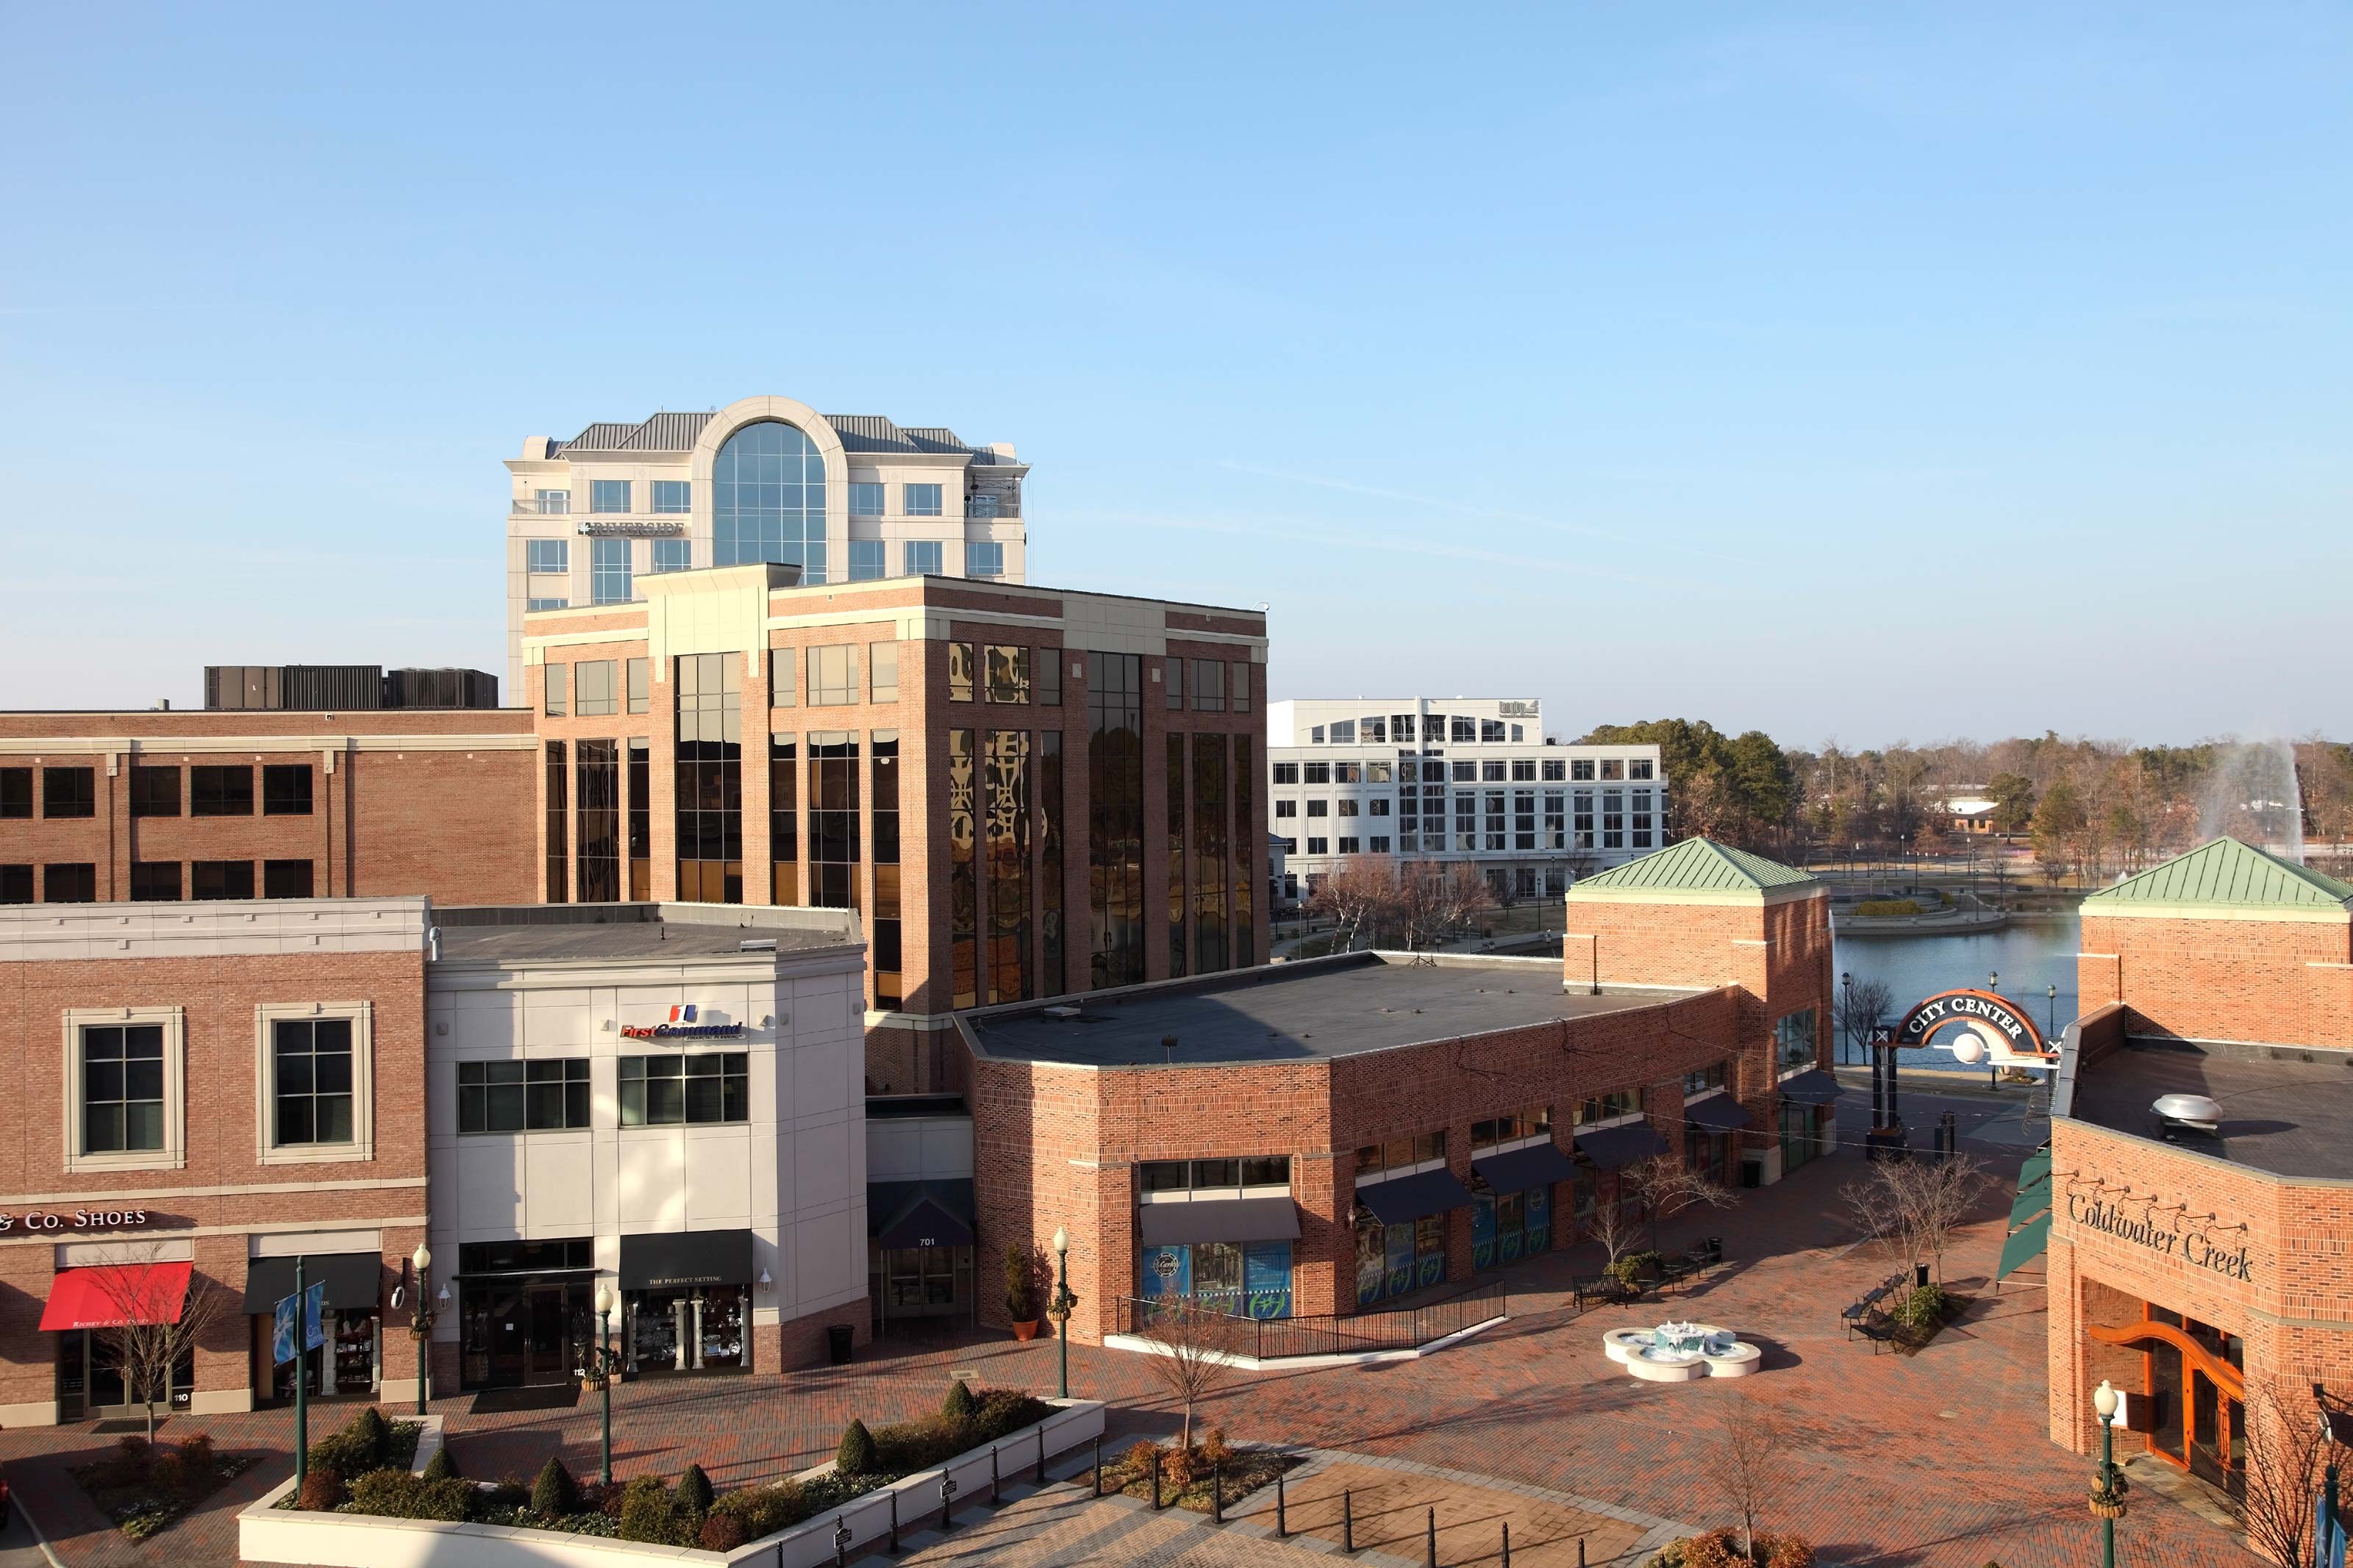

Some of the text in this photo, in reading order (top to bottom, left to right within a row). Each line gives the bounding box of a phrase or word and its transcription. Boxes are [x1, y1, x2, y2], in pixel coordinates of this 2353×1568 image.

[593, 522, 685, 536] RIVERSIDE
[1909, 998, 2023, 1039] CITY CENTER
[0, 1214, 14, 1231] &
[919, 1238, 935, 1247] 701
[2068, 1194, 2253, 1282] Coldwater Creek
[174, 1393, 188, 1401] 110
